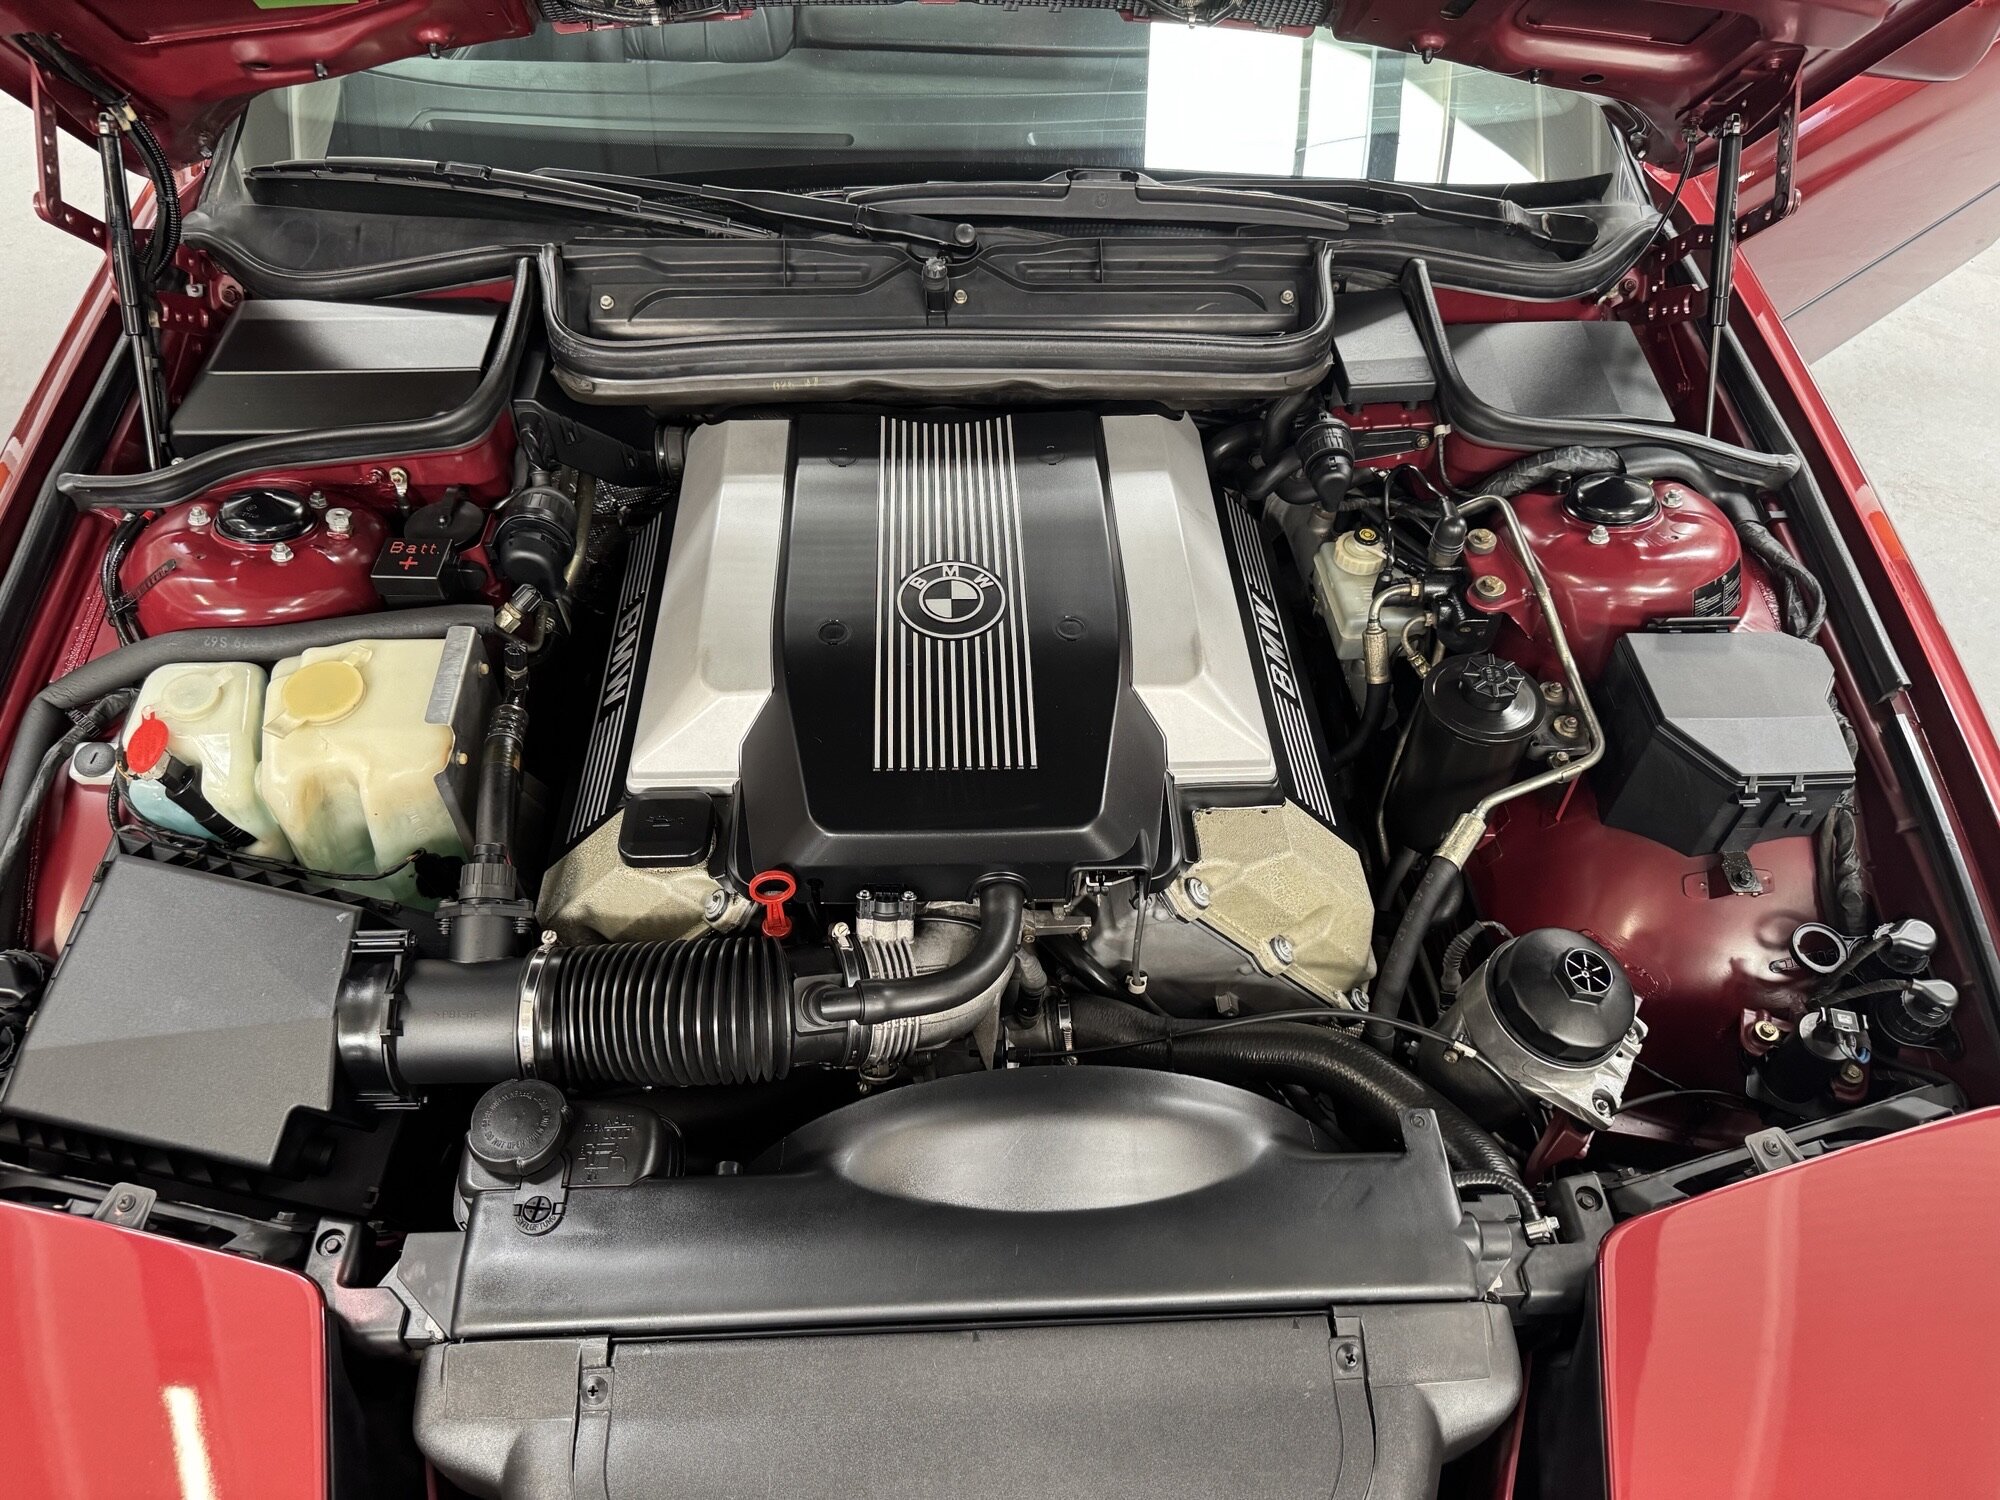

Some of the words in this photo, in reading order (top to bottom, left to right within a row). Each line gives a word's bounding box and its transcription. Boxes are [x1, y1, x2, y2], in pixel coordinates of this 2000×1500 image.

[389, 541, 440, 554] Batt.
[909, 565, 994, 590] BMW
[603, 602, 642, 707] BMW
[1251, 591, 1297, 699] BMW
